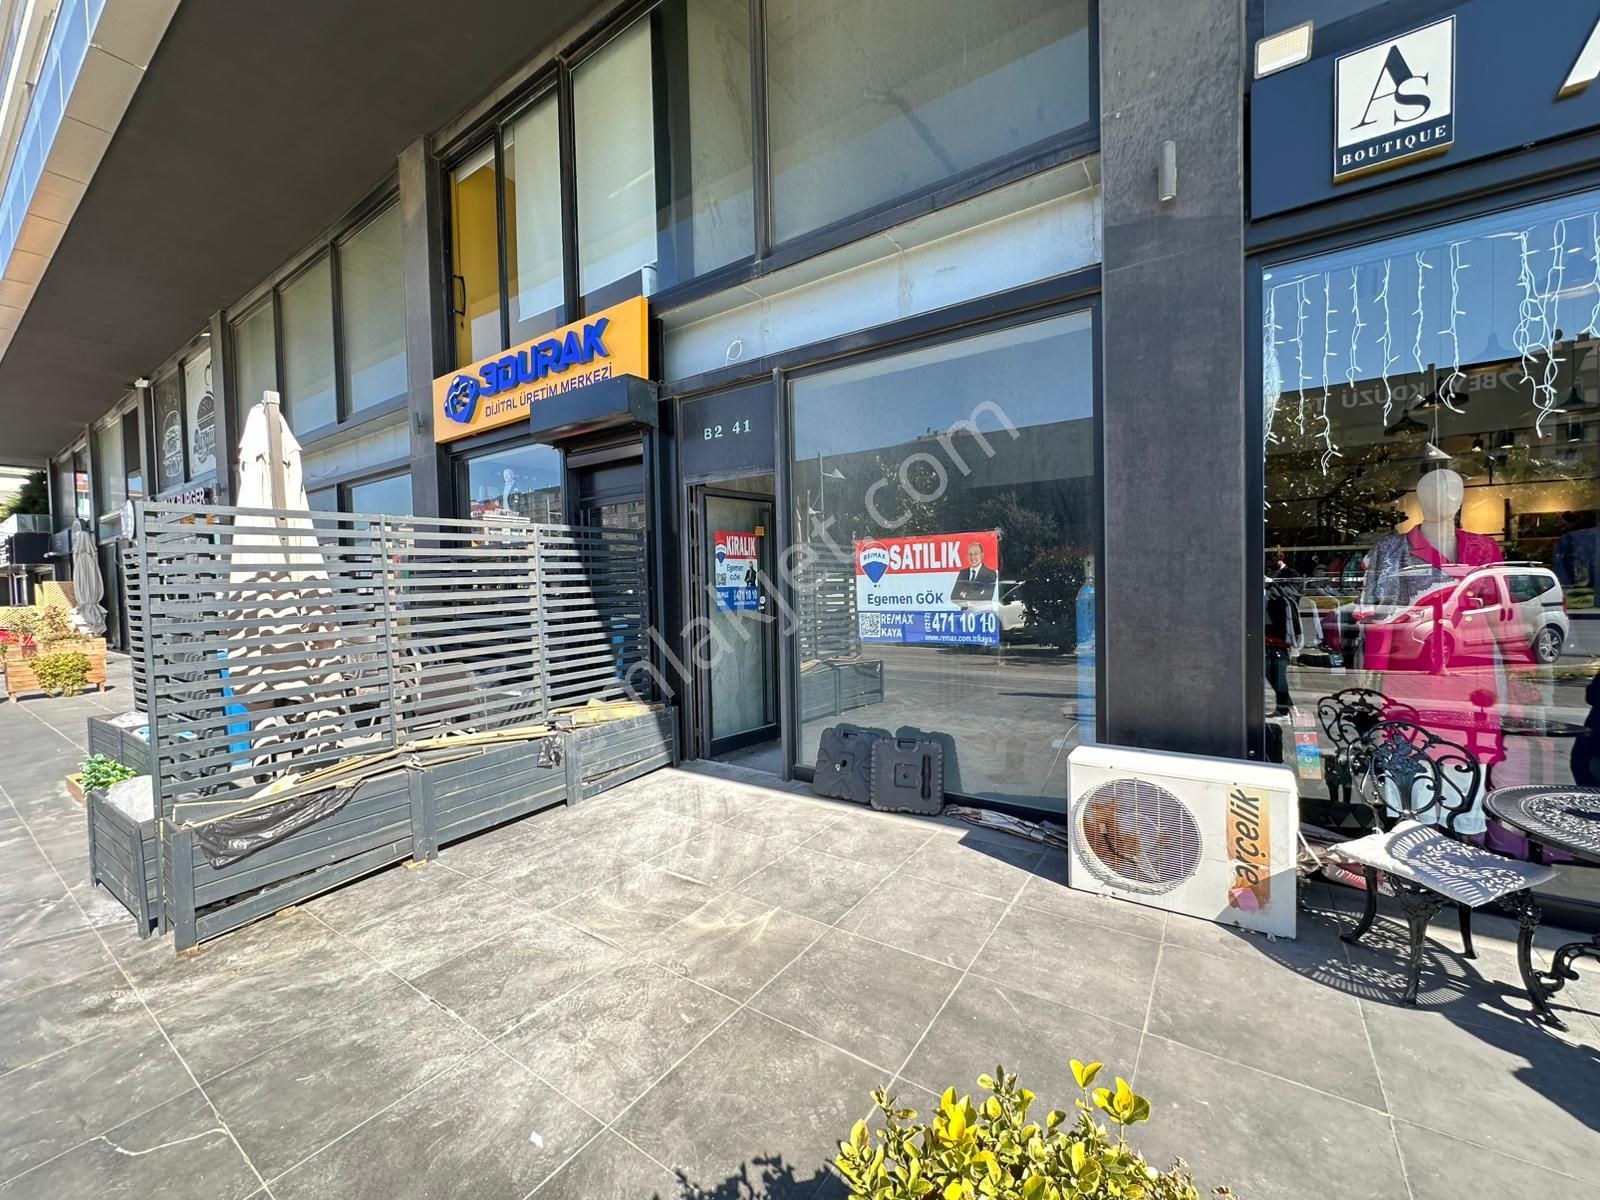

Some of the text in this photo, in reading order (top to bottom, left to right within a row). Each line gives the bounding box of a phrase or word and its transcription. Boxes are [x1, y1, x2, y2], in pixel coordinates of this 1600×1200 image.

[1350, 45, 1431, 130] AS
[1342, 124, 1447, 166] BOUTIQUE
[479, 317, 610, 397] 3DURAK
[519, 383, 558, 408] ÜRETİM
[560, 362, 613, 391] MERKEZİ
[704, 419, 751, 440] B2 41
[863, 551, 886, 561] RE/MAX
[889, 541, 962, 570] SATILIK
[867, 590, 943, 606] Egemen GÖK
[881, 613, 914, 625] RE/MAX
[932, 612, 996, 633] 471 10 10
[881, 628, 902, 637] KAYA
[1230, 788, 1267, 885] arçelik
